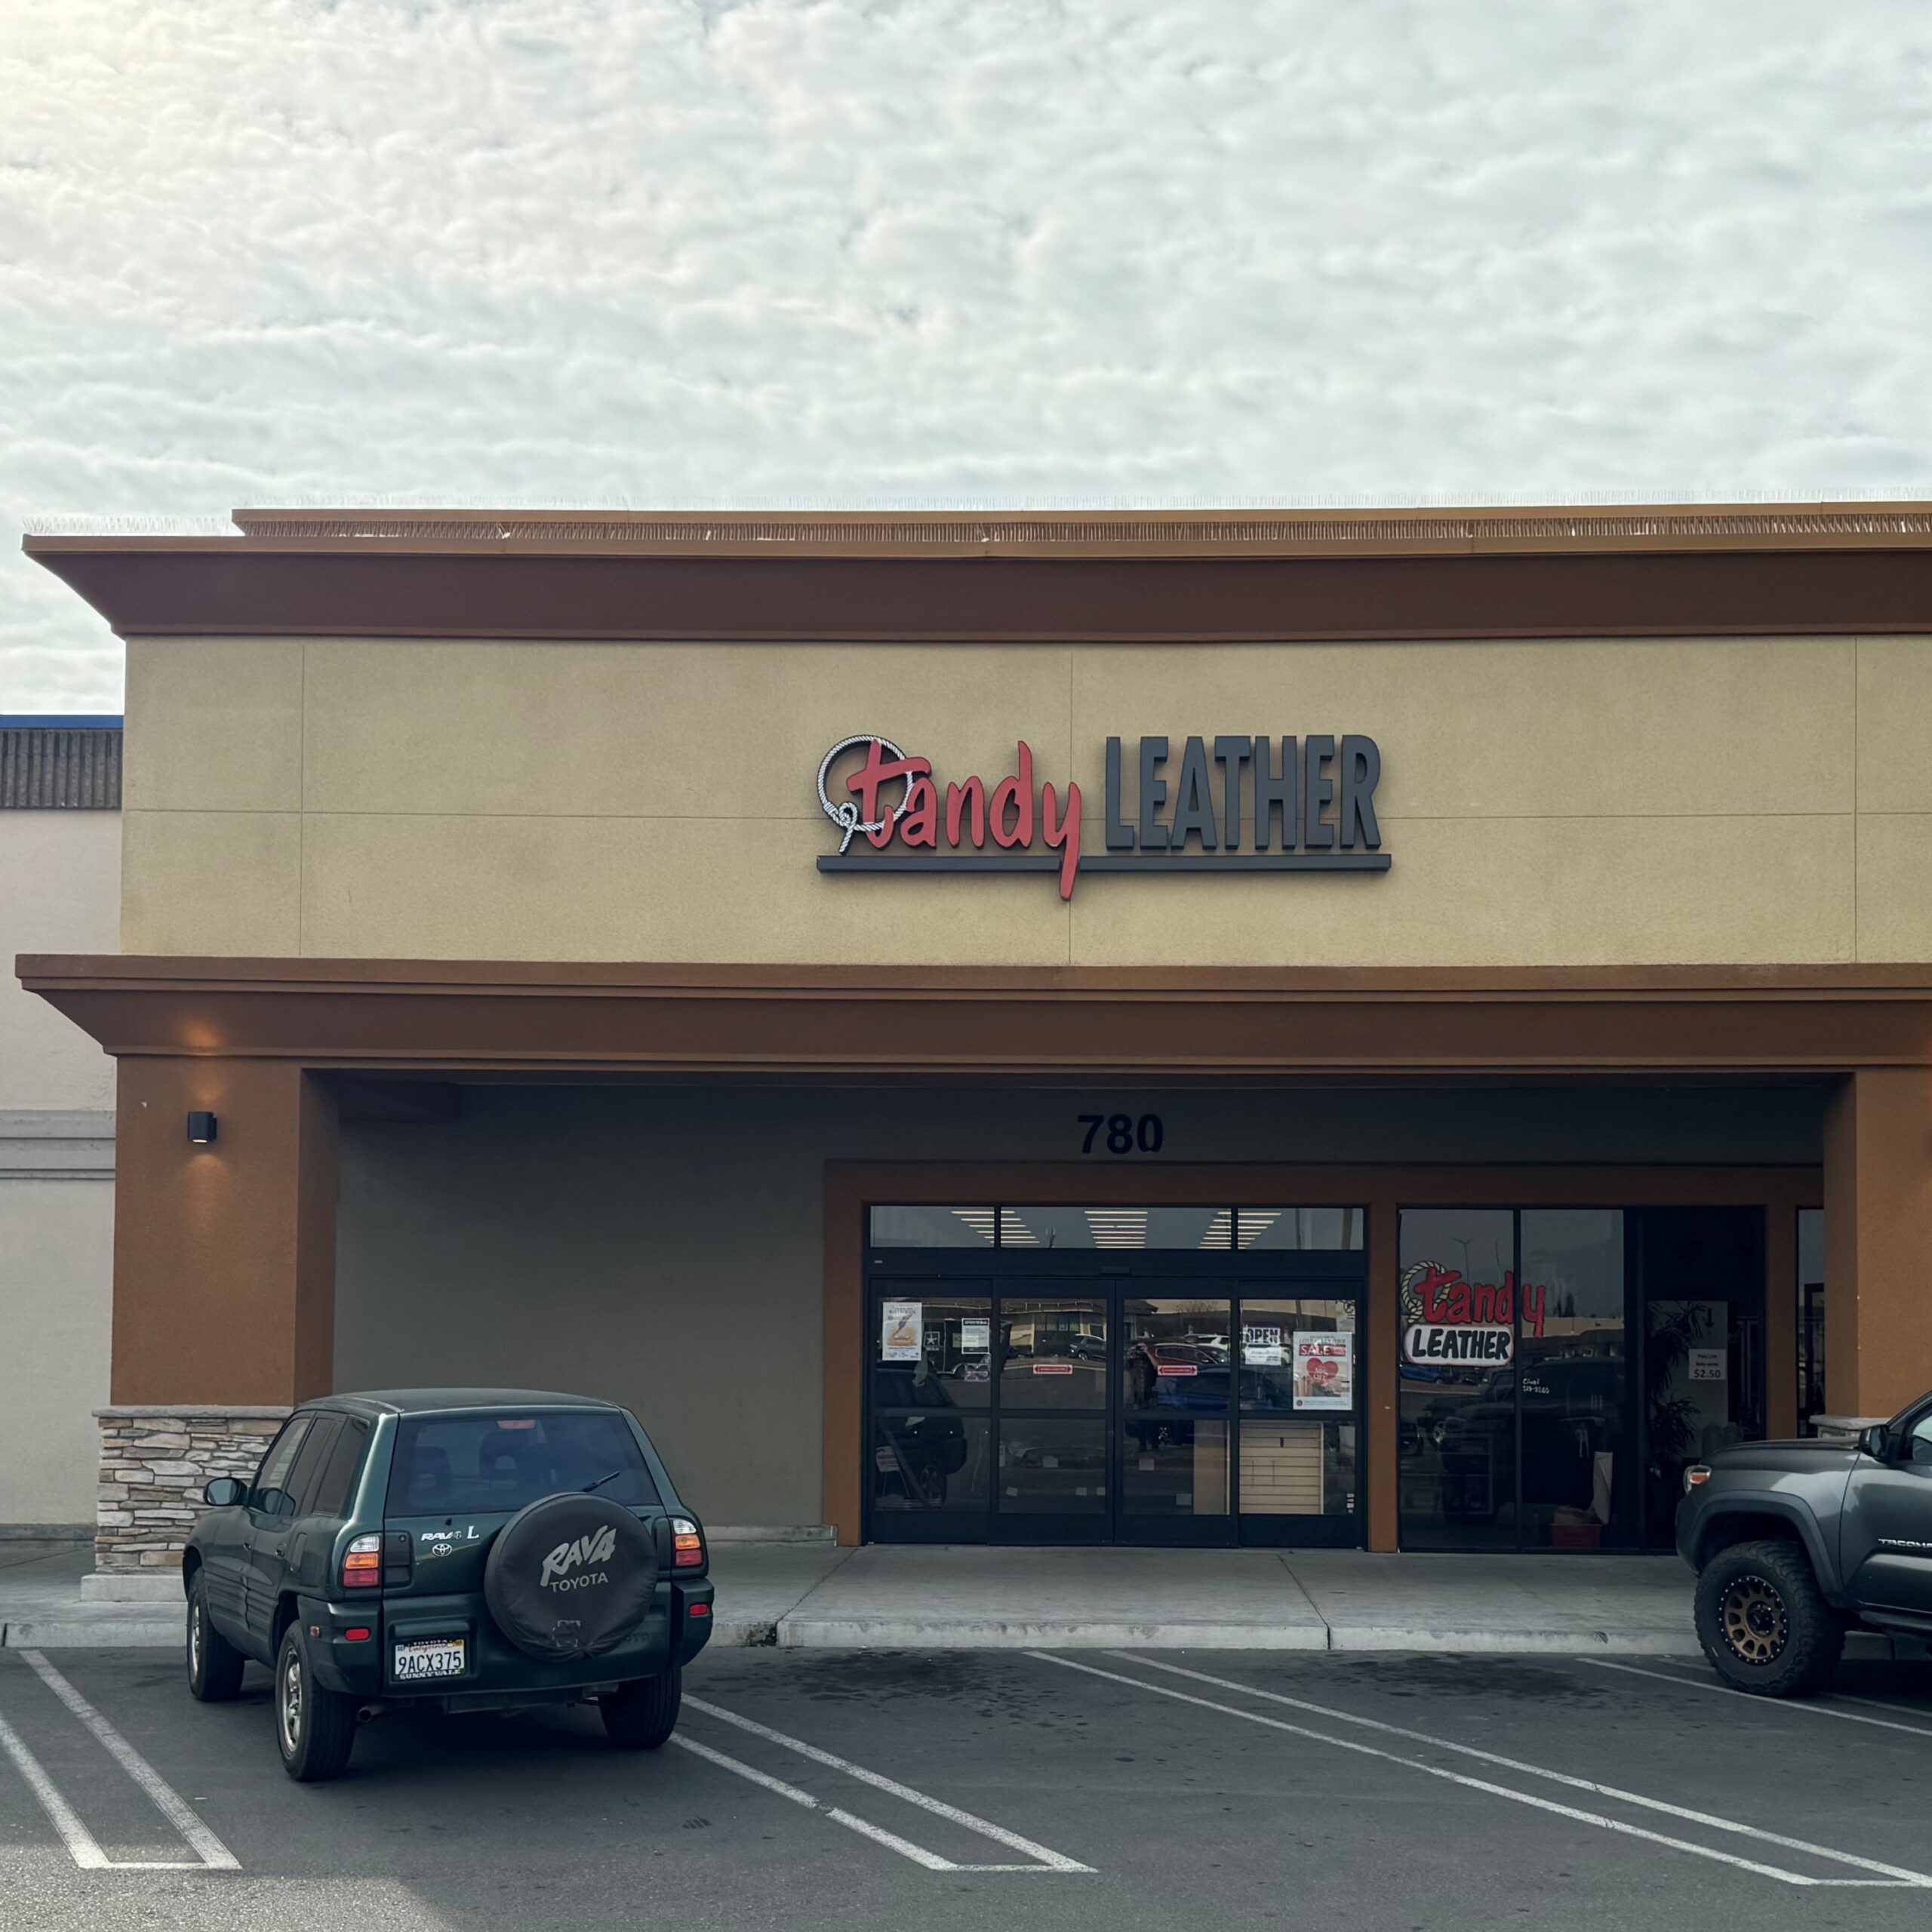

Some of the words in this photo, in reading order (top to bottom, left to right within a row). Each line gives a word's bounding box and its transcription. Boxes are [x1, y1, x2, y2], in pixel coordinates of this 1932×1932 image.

[1106, 735, 1382, 851] LEATHER
[1077, 1114, 1163, 1155] 780
[1414, 1267, 1546, 1339] tandy
[1247, 1328, 1278, 1343] OPEN
[1411, 1328, 1511, 1359] LEATHER
[1300, 1344, 1330, 1355] SALE
[1694, 1368, 1721, 1378] $2.50
[466, 1525, 480, 1539] L
[540, 1524, 617, 1587] RAV4
[549, 1572, 609, 1593] TOYOTA
[398, 1651, 462, 1675] 9ACX375
[399, 1669, 462, 1680] SUNNYVALE
